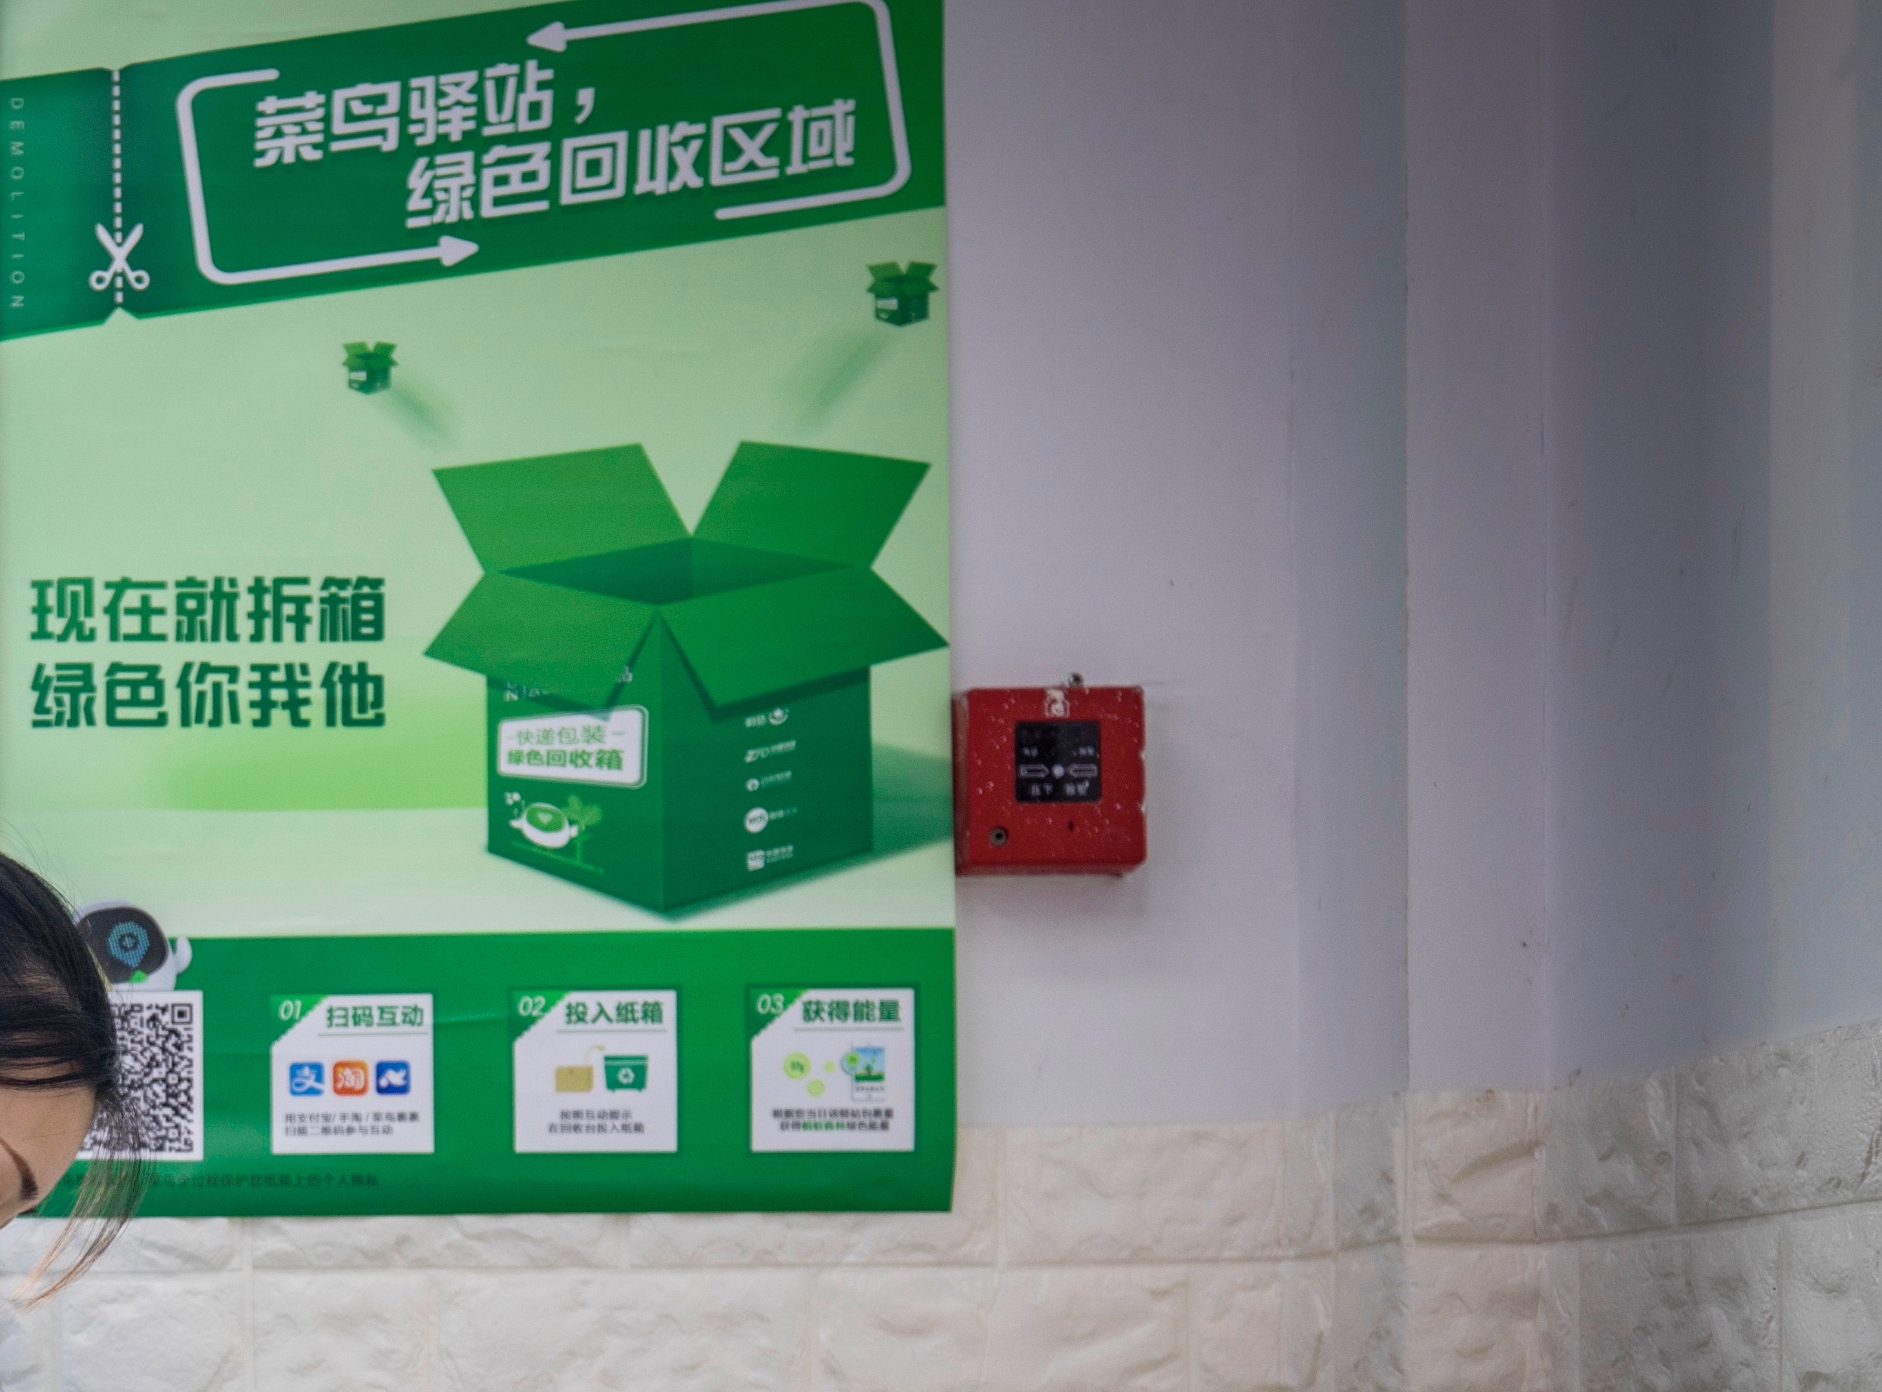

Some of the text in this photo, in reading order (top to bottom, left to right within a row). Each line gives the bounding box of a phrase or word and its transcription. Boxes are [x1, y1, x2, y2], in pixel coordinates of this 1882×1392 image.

[405, 98, 856, 228] 绿色回收区域
[9, 97, 25, 308] DEMOLITION
[30, 577, 385, 642] 现在就拆箱
[30, 662, 385, 728] 绿色你我他
[507, 748, 624, 770] 绿色回收箱
[278, 999, 302, 1021] 01
[326, 1004, 425, 1028] 扫码互动
[519, 996, 546, 1016] 02
[565, 1000, 664, 1025] 投入纸箱
[757, 994, 784, 1014] 03
[802, 998, 902, 1024] 获得能量
